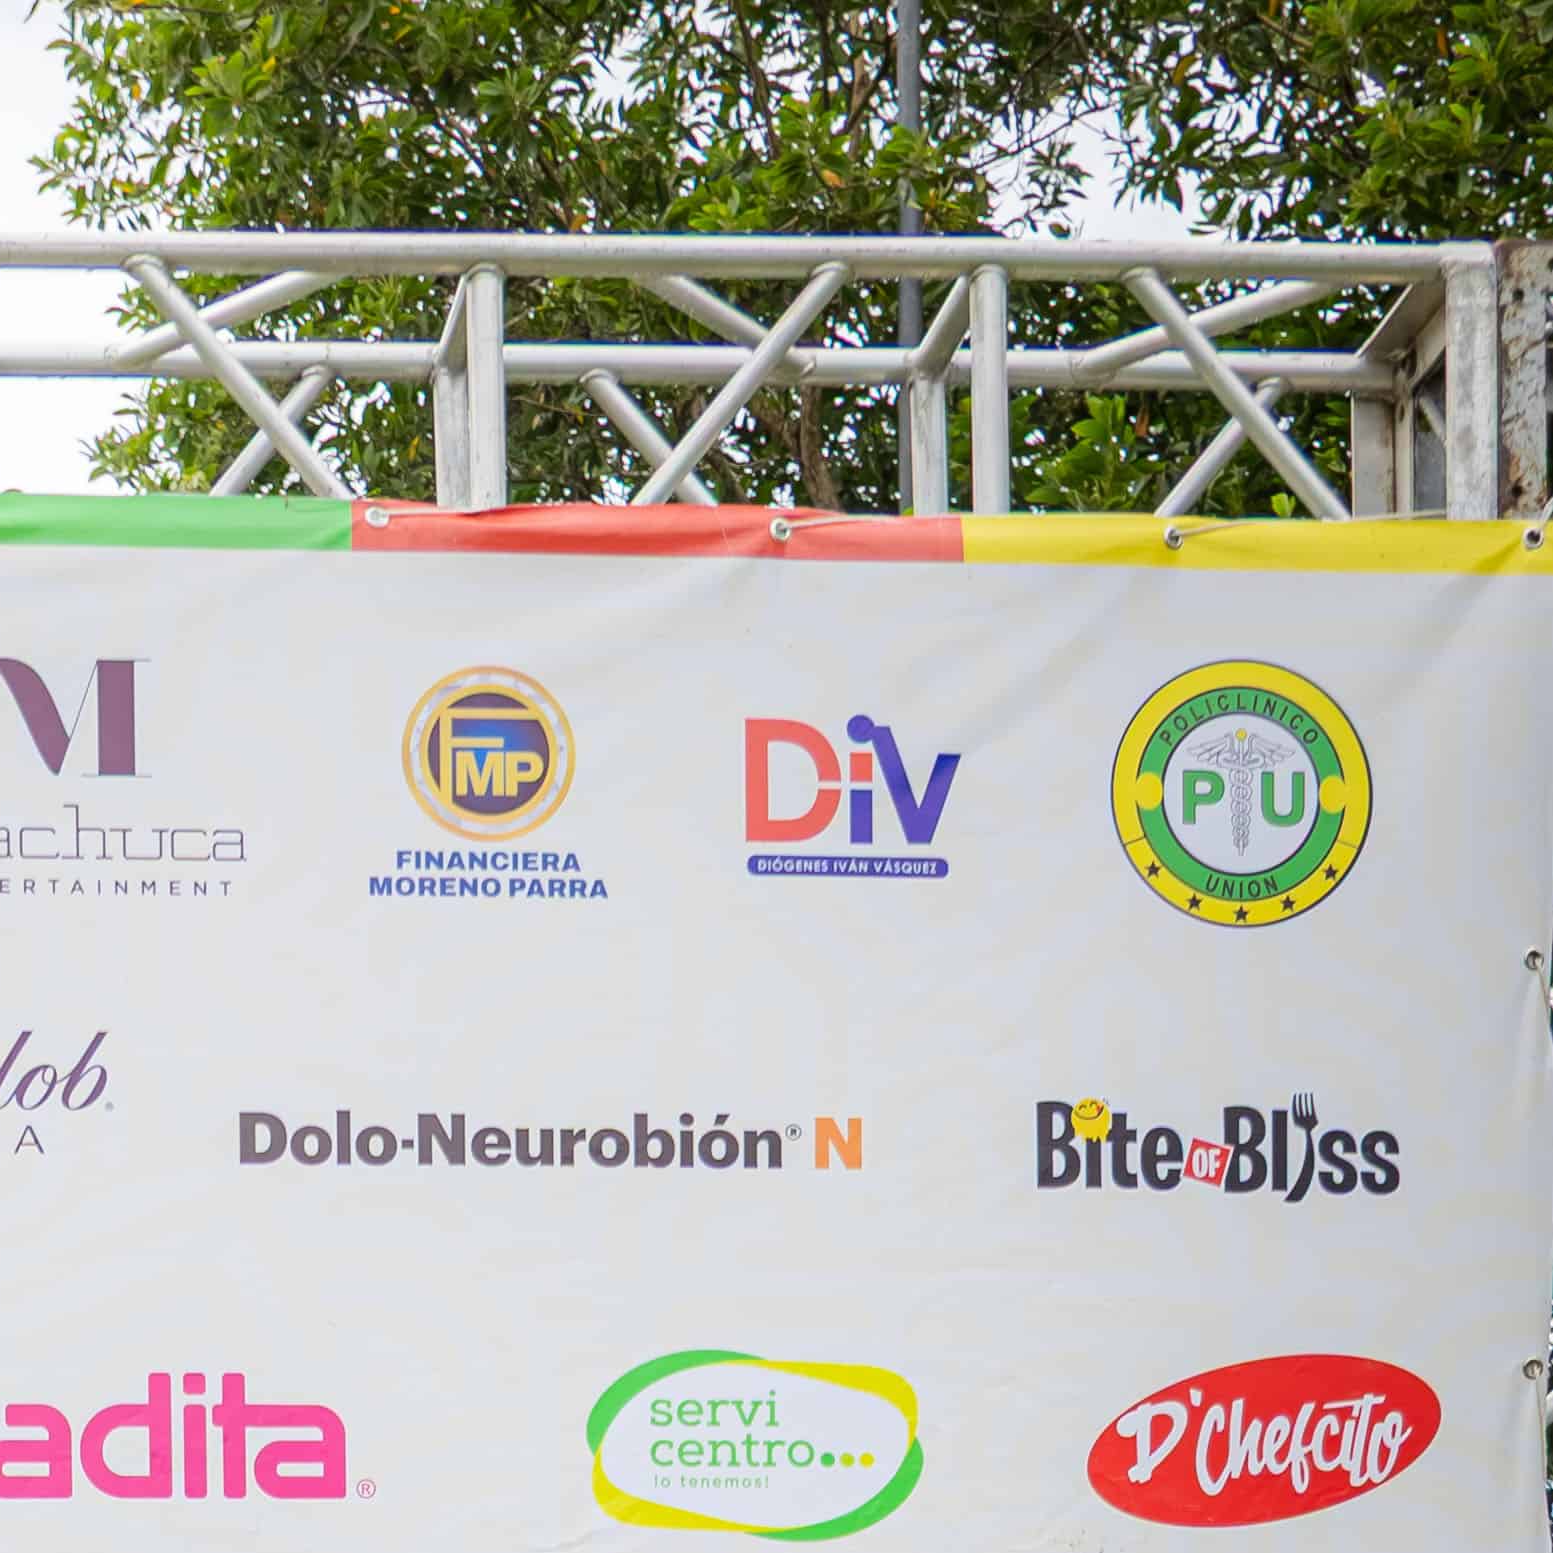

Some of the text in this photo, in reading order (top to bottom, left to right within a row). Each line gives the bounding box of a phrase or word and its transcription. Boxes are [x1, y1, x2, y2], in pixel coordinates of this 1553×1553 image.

[1159, 693, 1320, 747] POLICLINICO
[395, 849, 582, 872] FINANCIERA
[757, 857, 938, 876] DIÓGENES IVÁN VÁSQUEZ
[368, 876, 609, 899] MORENO PARRA
[1205, 872, 1281, 900] UNION
[814, 1117, 863, 1170] N
[1035, 1092, 1401, 1202] Bite OF Bliss
[649, 1389, 779, 1428] servi
[654, 1474, 672, 1489] lo
